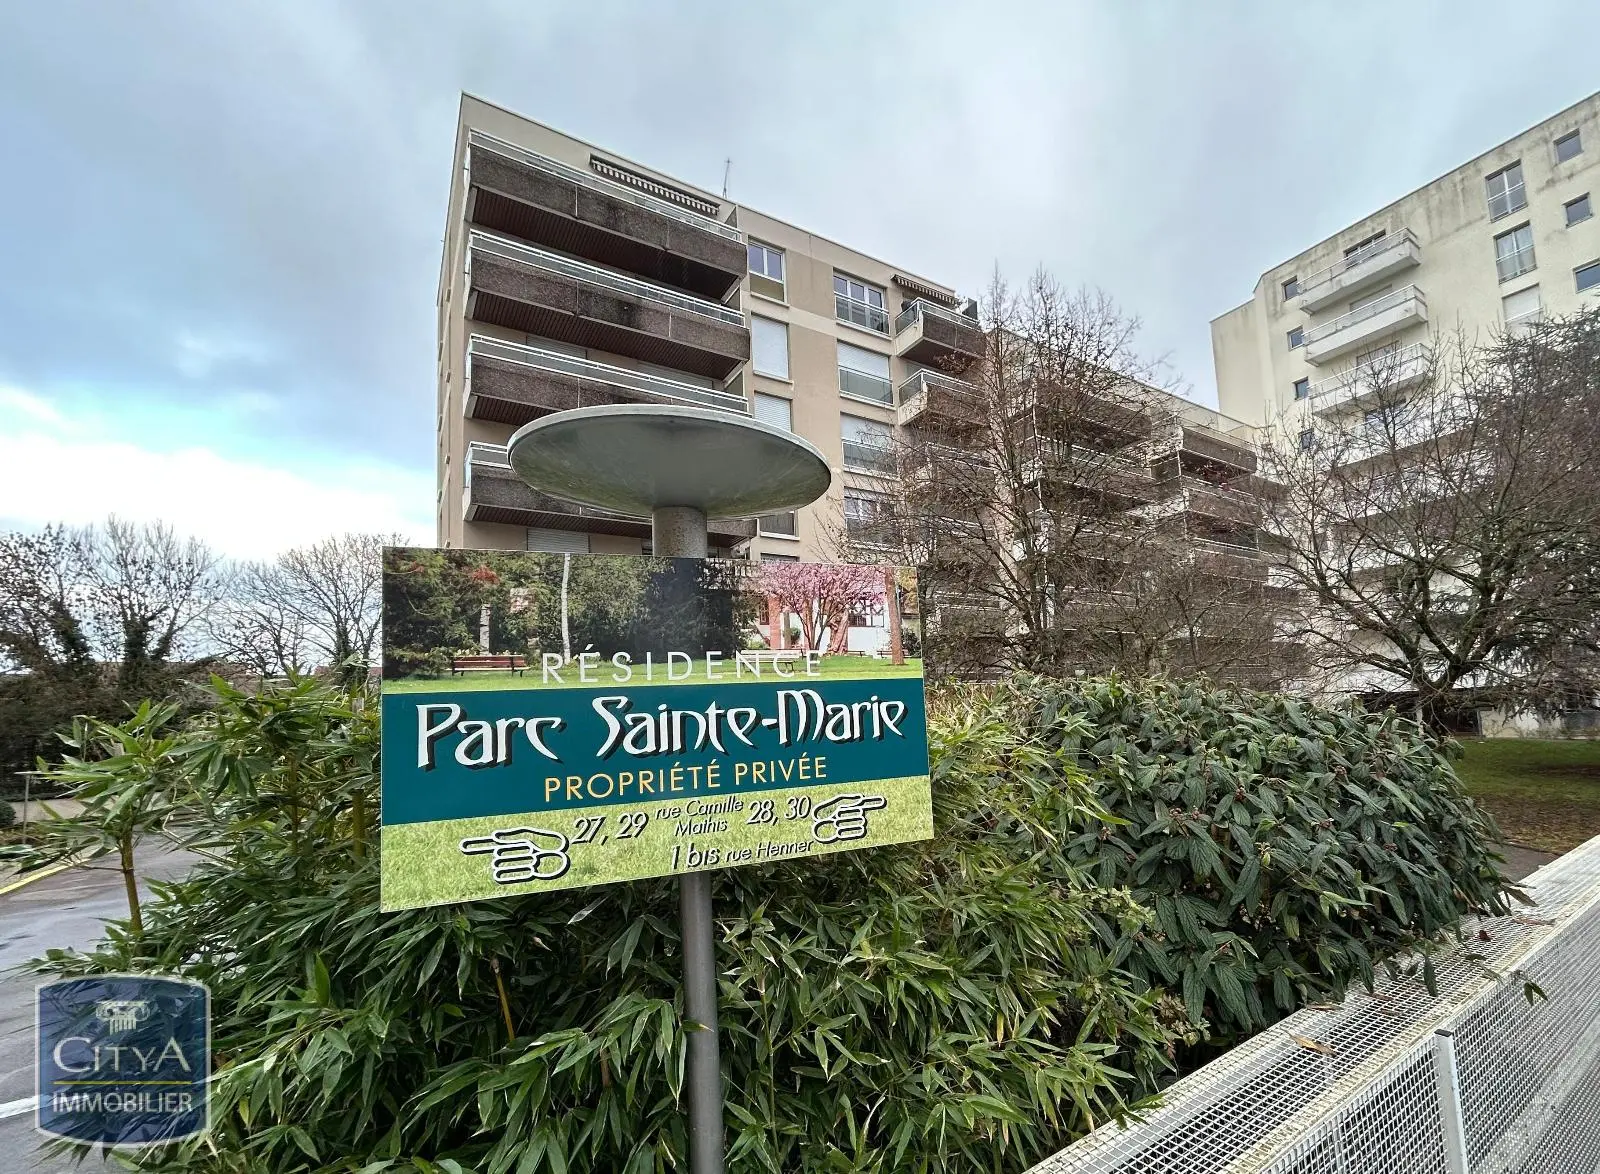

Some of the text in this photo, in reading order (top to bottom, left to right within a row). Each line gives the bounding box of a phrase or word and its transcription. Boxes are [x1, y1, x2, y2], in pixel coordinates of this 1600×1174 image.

[542, 643, 822, 685] RÉSIDENCE
[415, 688, 908, 772] Parc Sainte-Marie
[544, 751, 828, 803] PROPRIÉTÉ PRIVÉE
[570, 795, 812, 846] 27, 29 rue Camille 28, 30
[674, 816, 728, 837] Mathis
[670, 839, 815, 870] 1 bis rue Henner
